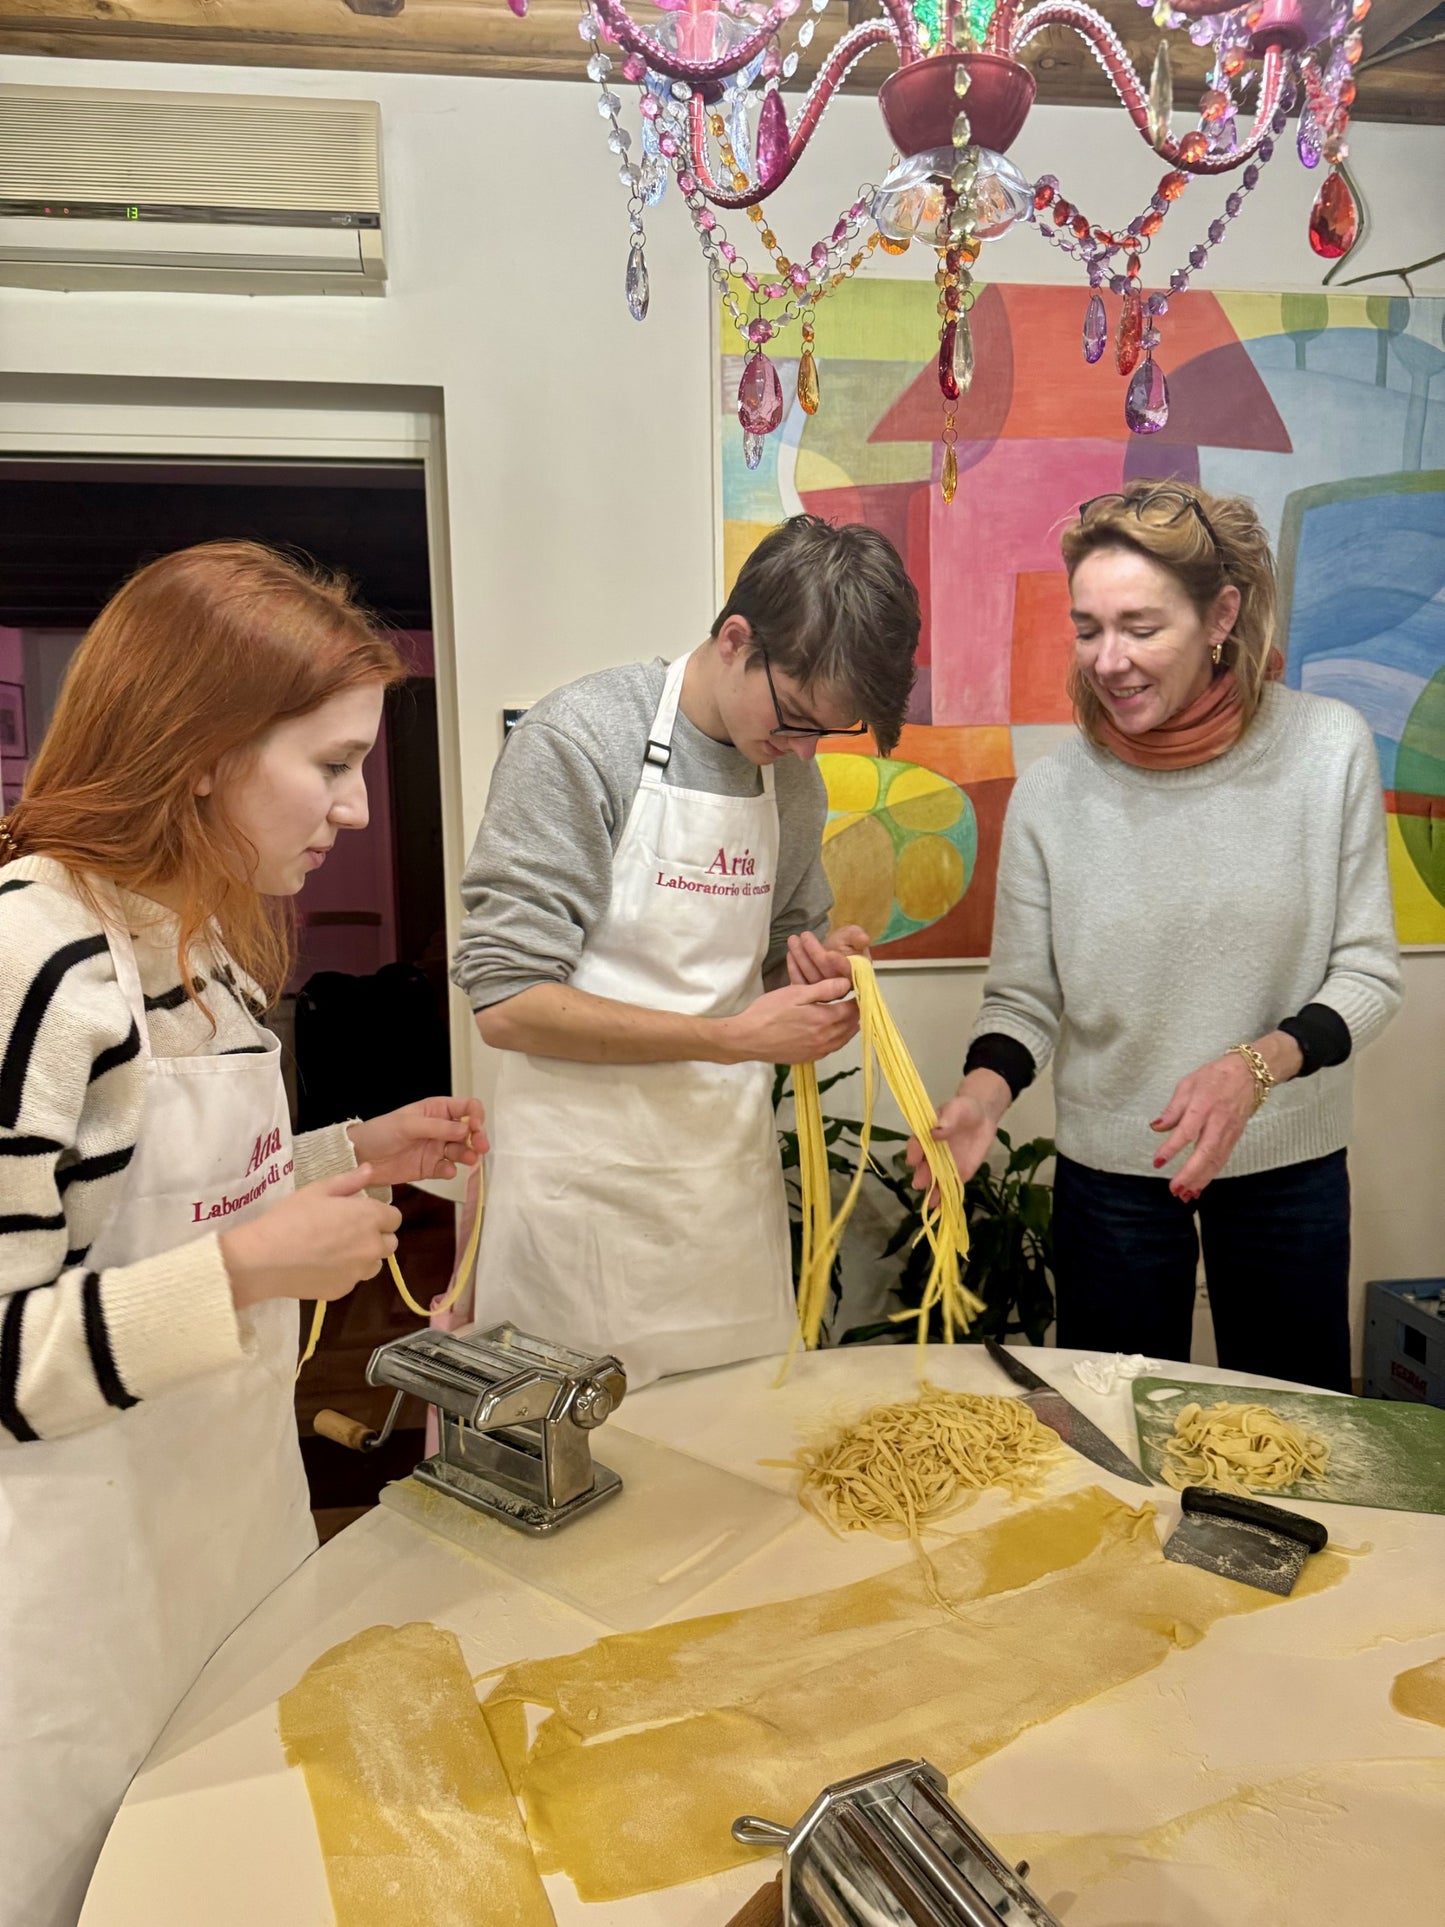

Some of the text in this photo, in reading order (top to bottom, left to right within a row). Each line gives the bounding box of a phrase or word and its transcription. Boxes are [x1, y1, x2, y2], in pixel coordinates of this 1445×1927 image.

[126, 207, 139, 220] 13
[704, 847, 755, 876] Aria
[656, 871, 740, 897] Laboratorio
[742, 882, 751, 896] di
[267, 1163, 281, 1185] di
